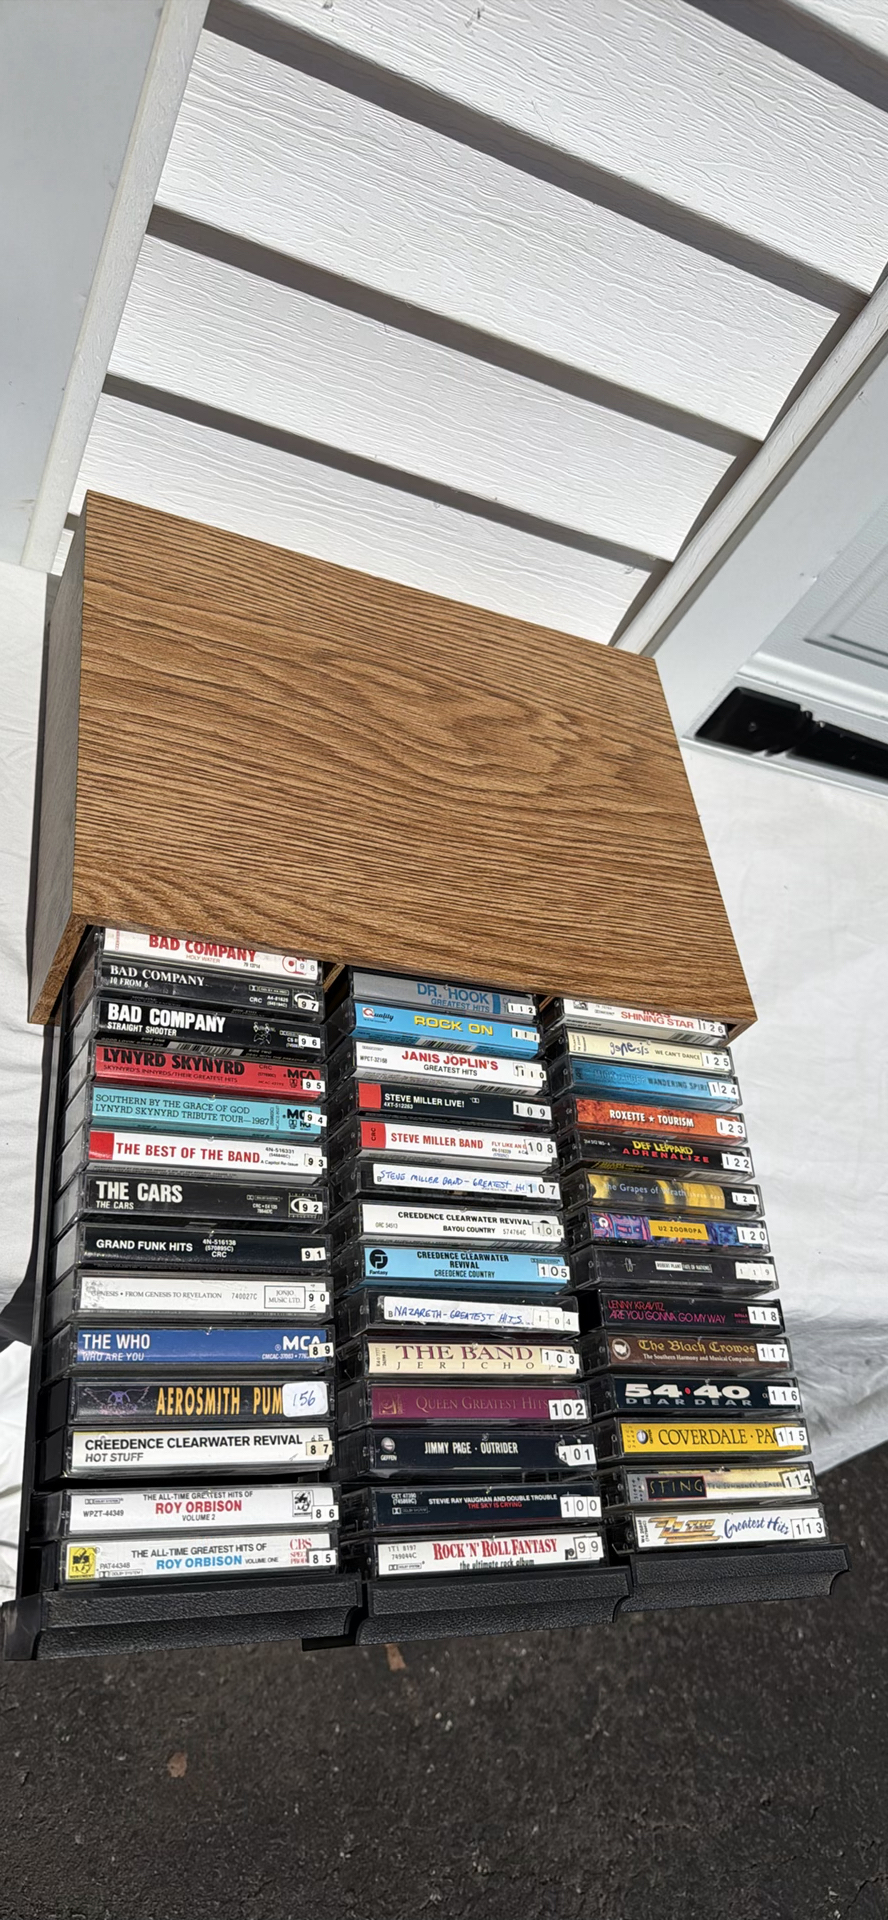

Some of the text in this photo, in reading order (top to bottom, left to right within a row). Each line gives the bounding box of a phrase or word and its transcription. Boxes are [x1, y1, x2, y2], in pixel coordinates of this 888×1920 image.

[149, 935, 256, 962] BAD COMPANY
[110, 977, 117, 985] 10
[120, 979, 142, 987] FROM
[111, 965, 205, 986] BAD COMPANY
[417, 984, 489, 1004] DR. HOOK
[431, 998, 490, 1012] GREATEST HITS
[108, 1003, 226, 1033] BAD COMPANY
[414, 1015, 493, 1036] ROCK ON
[621, 1012, 694, 1028] SHINING STAR
[108, 1023, 177, 1036] STRAIGHT SHOOTER
[702, 1023, 724, 1033] 126
[610, 1041, 649, 1056] genesis
[104, 1048, 167, 1067] LYNYRD
[172, 1055, 245, 1076] SKYNYRD
[402, 1051, 498, 1070] JANIS JOPLIN'S
[648, 1077, 709, 1091] WANDERING SPIRI
[96, 1094, 147, 1105] SOUTHERN
[149, 1098, 161, 1106] BY
[163, 1099, 181, 1108] THE
[183, 1101, 213, 1111] GRACE
[230, 1106, 250, 1114] GOD
[384, 1093, 465, 1107] STEVE MILLER LIVE!
[95, 1104, 218, 1121] LYNYRD SKYNYRD TRIBUTE
[610, 1110, 695, 1127] ROXETTE TOURISM
[391, 1133, 483, 1149] STEVE MILLER BAND
[632, 1140, 693, 1155] DEF LEPPARD
[116, 1143, 142, 1155] THE
[145, 1144, 177, 1157] BEST
[181, 1146, 196, 1159] OF
[201, 1148, 223, 1161] THE
[228, 1149, 260, 1163] BAND
[623, 1147, 709, 1164] ADRENALIZE
[380, 1170, 511, 1189] STEVE MILLER GREATEST
[96, 1181, 183, 1203] THE CARS
[96, 1201, 134, 1210] THE CARS
[398, 1212, 444, 1221] CREEDENCE
[446, 1215, 497, 1223] CLEARWATER
[670, 1226, 702, 1234] ZOOROPA
[96, 1239, 193, 1251] GRAND FUNK HITS
[417, 1251, 509, 1262] CREEDENCE CLEARWATER
[450, 1261, 479, 1269] REVIVAL
[541, 1266, 568, 1278] 105
[608, 1301, 665, 1311] LENNY KRAVITZ
[83, 1334, 150, 1349] THE WHO
[639, 1340, 756, 1354] The Black Crowes
[82, 1352, 144, 1361] WHO ARE YOU
[396, 1345, 453, 1360] THE
[462, 1346, 533, 1360] BAND
[676, 1355, 699, 1363] Harmony
[156, 1387, 283, 1415] AEROSMITH PUM
[293, 1390, 316, 1407] 156
[416, 1397, 458, 1412] QUEEN
[462, 1397, 519, 1410] GREATEST
[551, 1403, 584, 1416] 102
[85, 1435, 302, 1450] CREEDENCE CLEARWATER REVIVAL
[659, 1430, 747, 1445] COVERDALE
[425, 1442, 518, 1454] JIMMY PAGE OUTRIDER
[85, 1452, 144, 1462] HOT STUFF
[650, 1480, 703, 1494] STING
[155, 1500, 242, 1515] ROY ORBISON
[428, 1497, 449, 1505] STEVIE
[724, 1516, 789, 1539] Greatest Hits
[131, 1543, 267, 1559] THE ALL-TIME GREATEST HITS OF
[289, 1538, 312, 1550] CBS
[432, 1541, 465, 1560] ROCK
[481, 1540, 511, 1557] ROLL
[512, 1538, 557, 1555] FANTASY
[156, 1556, 242, 1570] ROY ORBISON
